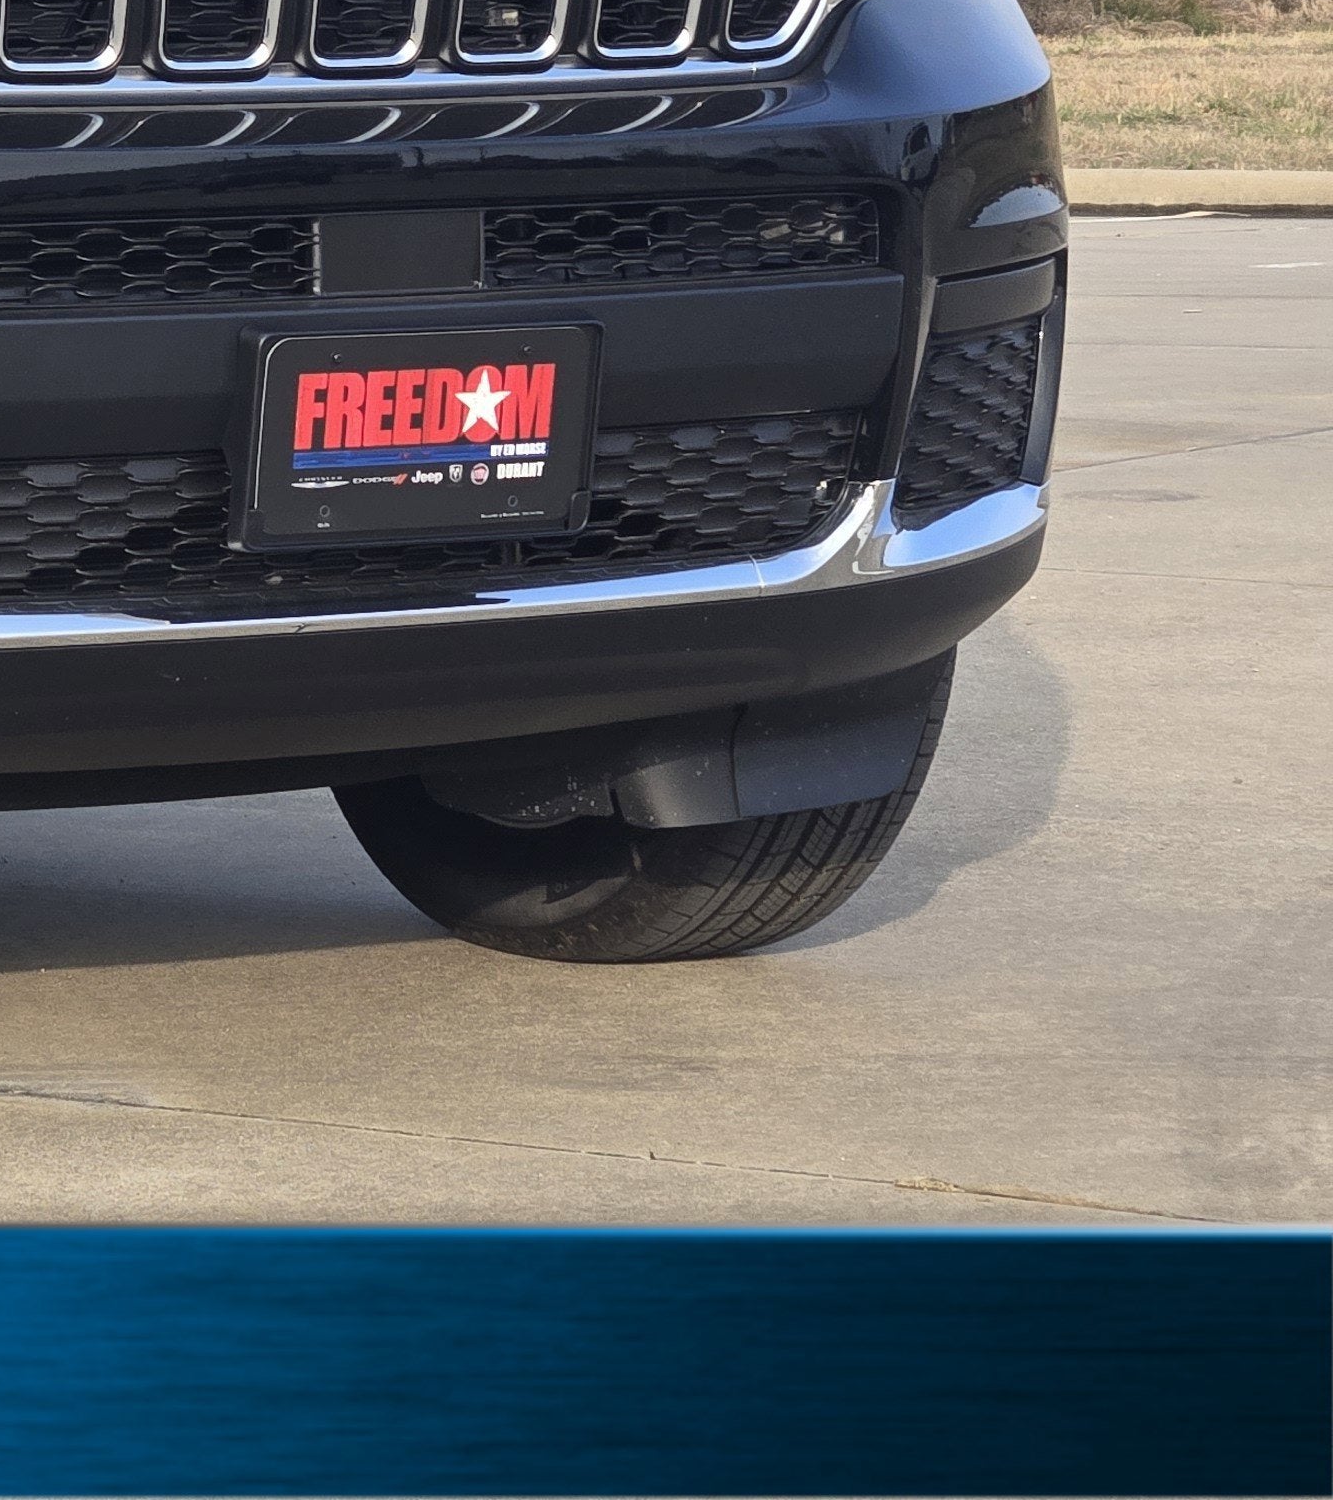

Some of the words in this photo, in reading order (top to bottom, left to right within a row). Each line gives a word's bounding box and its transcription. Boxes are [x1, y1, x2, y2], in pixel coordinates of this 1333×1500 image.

[293, 363, 557, 450] FREEDOM
[411, 469, 444, 485] Jeep
[496, 461, 546, 480] DURANT
